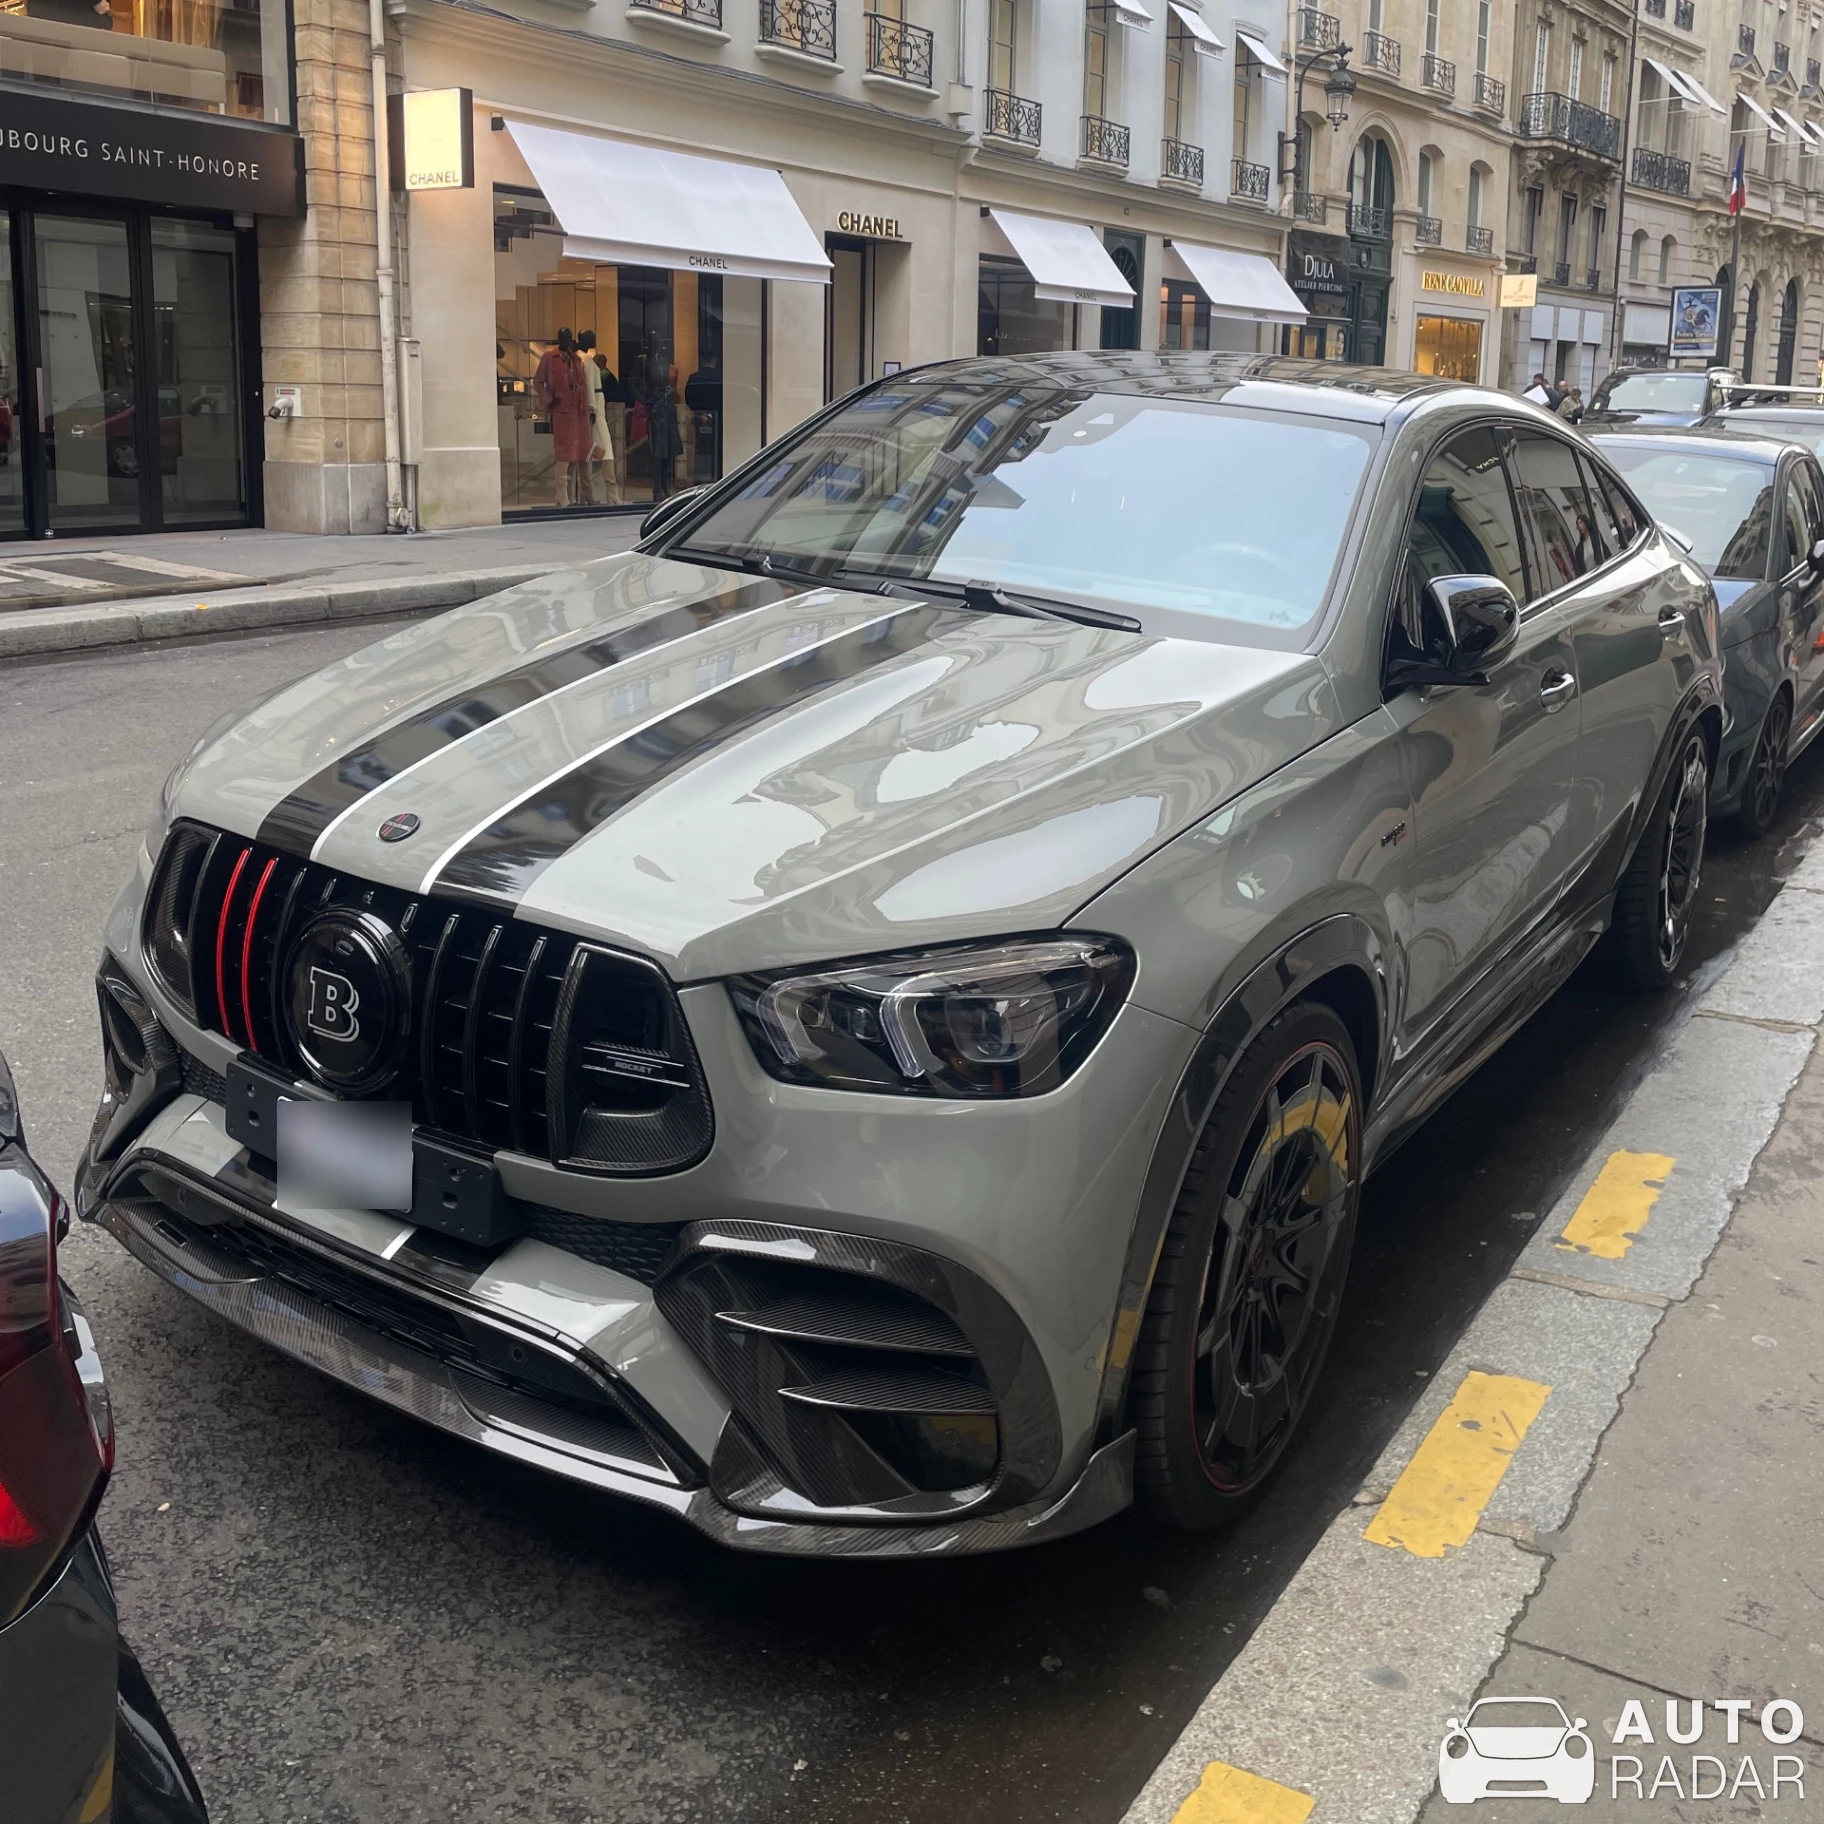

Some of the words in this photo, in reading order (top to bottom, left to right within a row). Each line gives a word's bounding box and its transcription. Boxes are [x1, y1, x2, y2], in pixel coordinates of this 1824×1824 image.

[101, 143, 260, 181] SAINT-HONORE
[409, 171, 459, 185] CHANEL
[837, 211, 903, 238] CHANEL
[689, 255, 728, 269] CHANEL
[1294, 279, 1316, 290] ATELIER
[1318, 282, 1343, 292] PIERCING
[307, 965, 360, 1043] B
[614, 1061, 653, 1074] ROCKET
